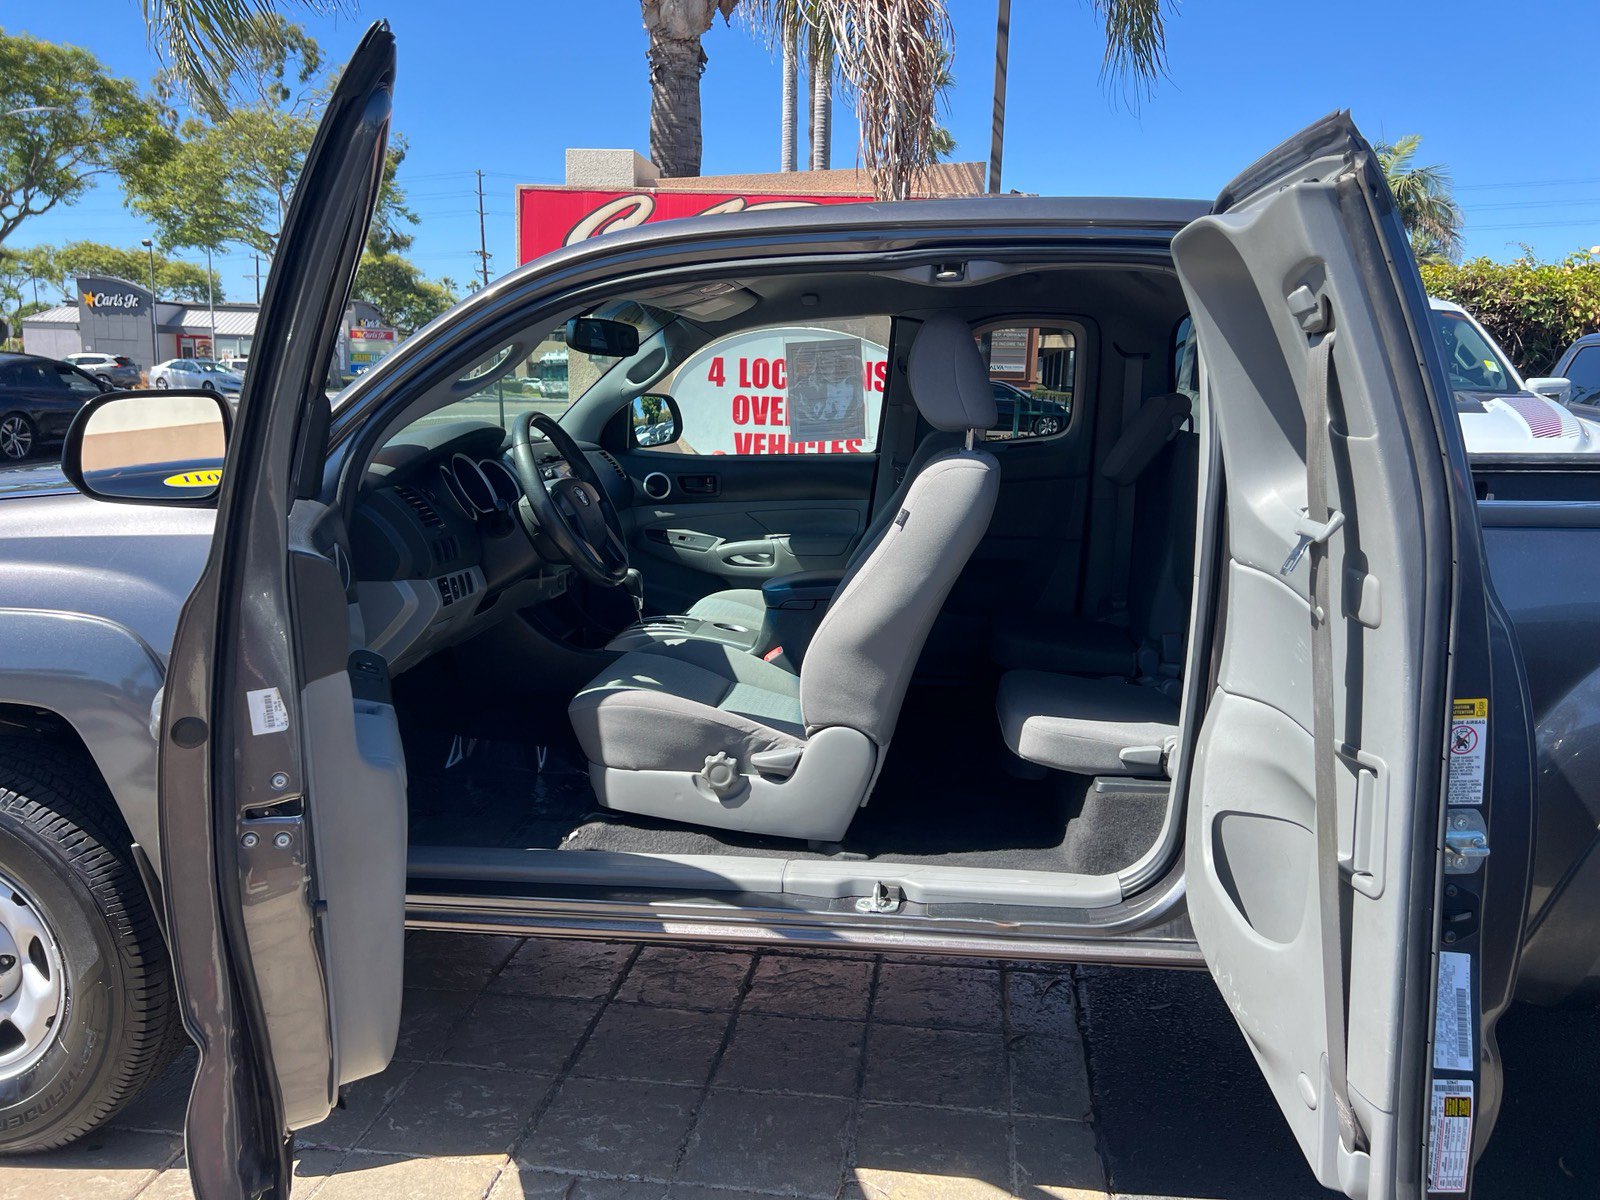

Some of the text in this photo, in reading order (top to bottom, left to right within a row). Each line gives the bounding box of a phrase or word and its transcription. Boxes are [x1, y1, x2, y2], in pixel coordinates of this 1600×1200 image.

[94, 293, 123, 307] Carl's
[707, 357, 726, 388] 4
[732, 395, 790, 426] OVE
